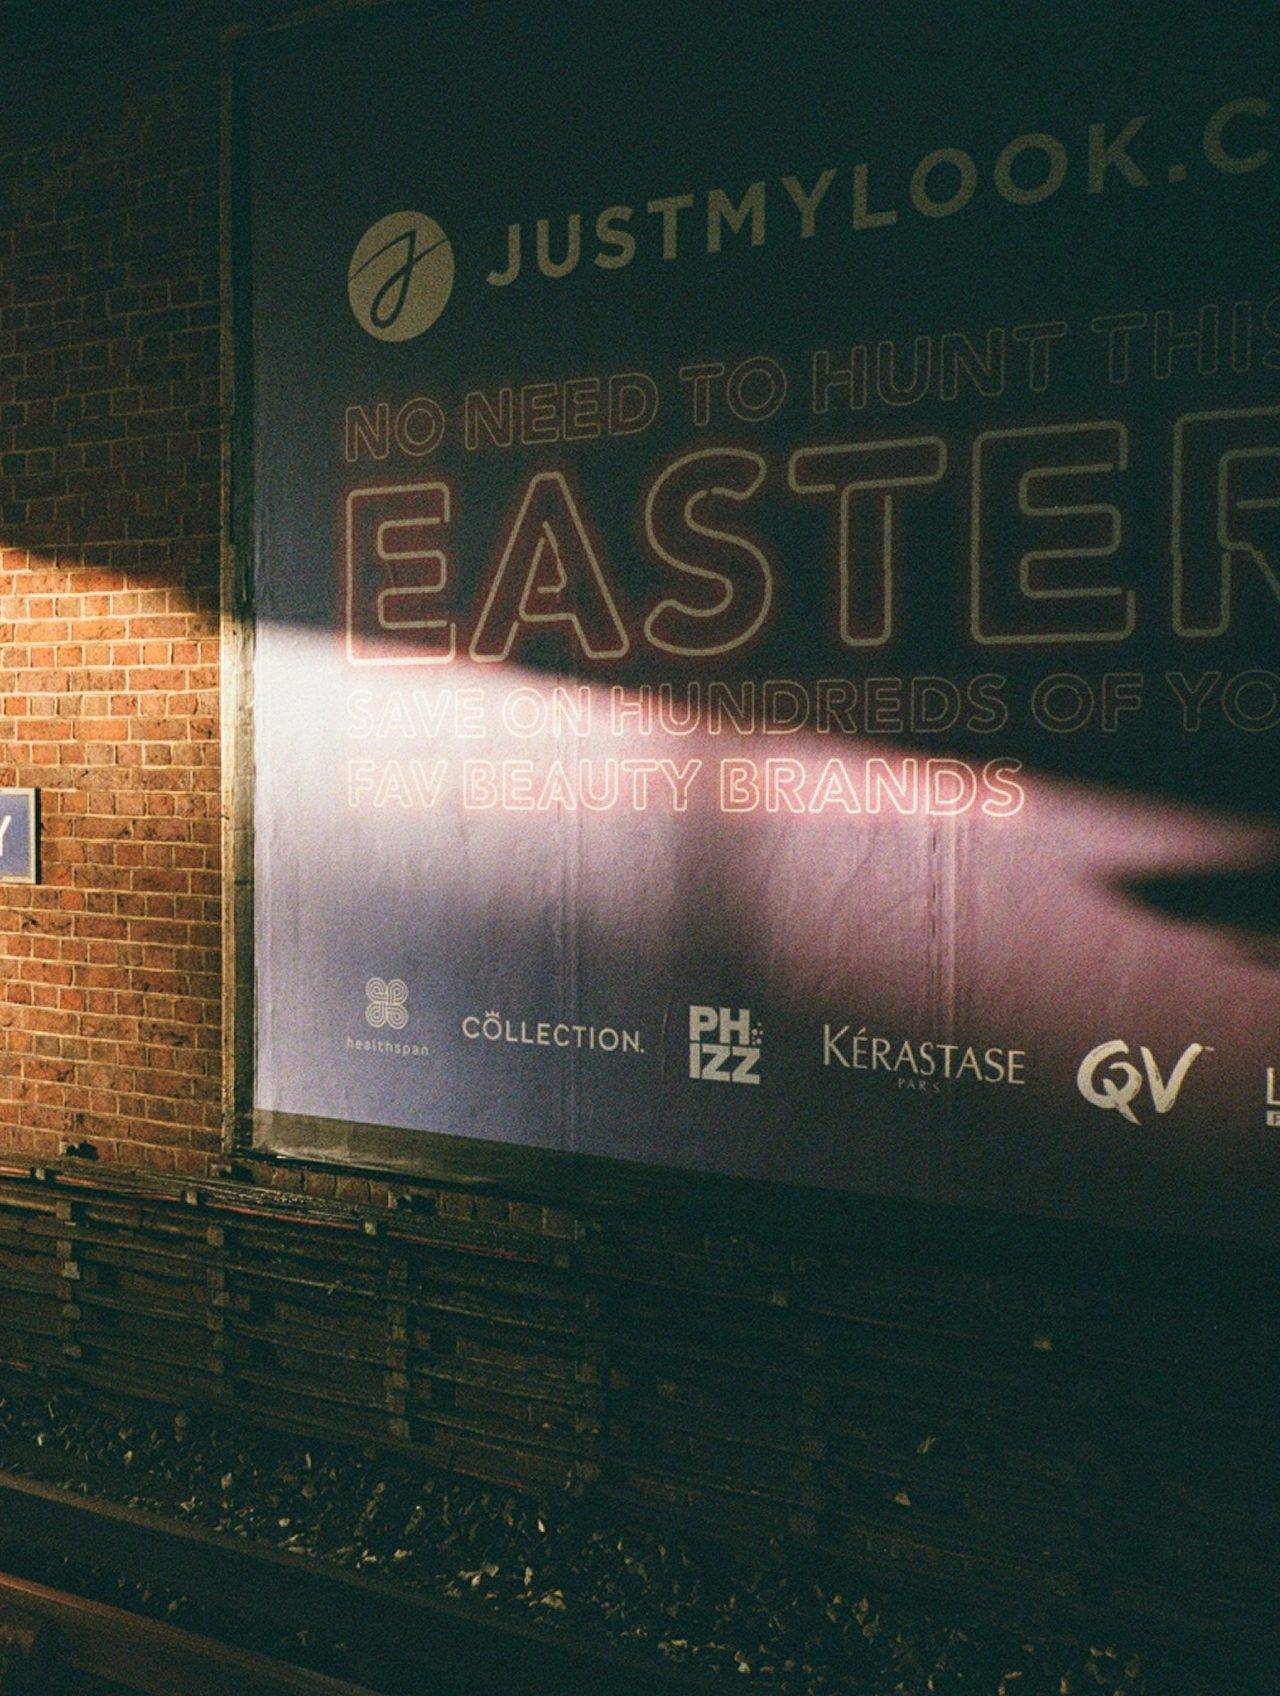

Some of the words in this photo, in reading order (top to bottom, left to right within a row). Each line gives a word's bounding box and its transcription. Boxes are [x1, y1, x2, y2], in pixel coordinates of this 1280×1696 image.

[345, 397, 445, 462] NO
[464, 372, 659, 450] NEED
[679, 356, 788, 426] TO
[811, 321, 1068, 415] HUNT
[1091, 299, 1280, 385] THI
[345, 407, 1280, 667] EASTER
[346, 687, 486, 738] SAVE
[501, 686, 592, 738] ON
[610, 673, 1009, 737] HUNDREDS
[1030, 673, 1144, 733] OF
[347, 760, 448, 808] FAV
[462, 758, 703, 812] BEAUTY
[719, 757, 1025, 817] BRANDS
[822, 1024, 1026, 1085] KÉRASTASE
[898, 1078, 941, 1094] PARS
